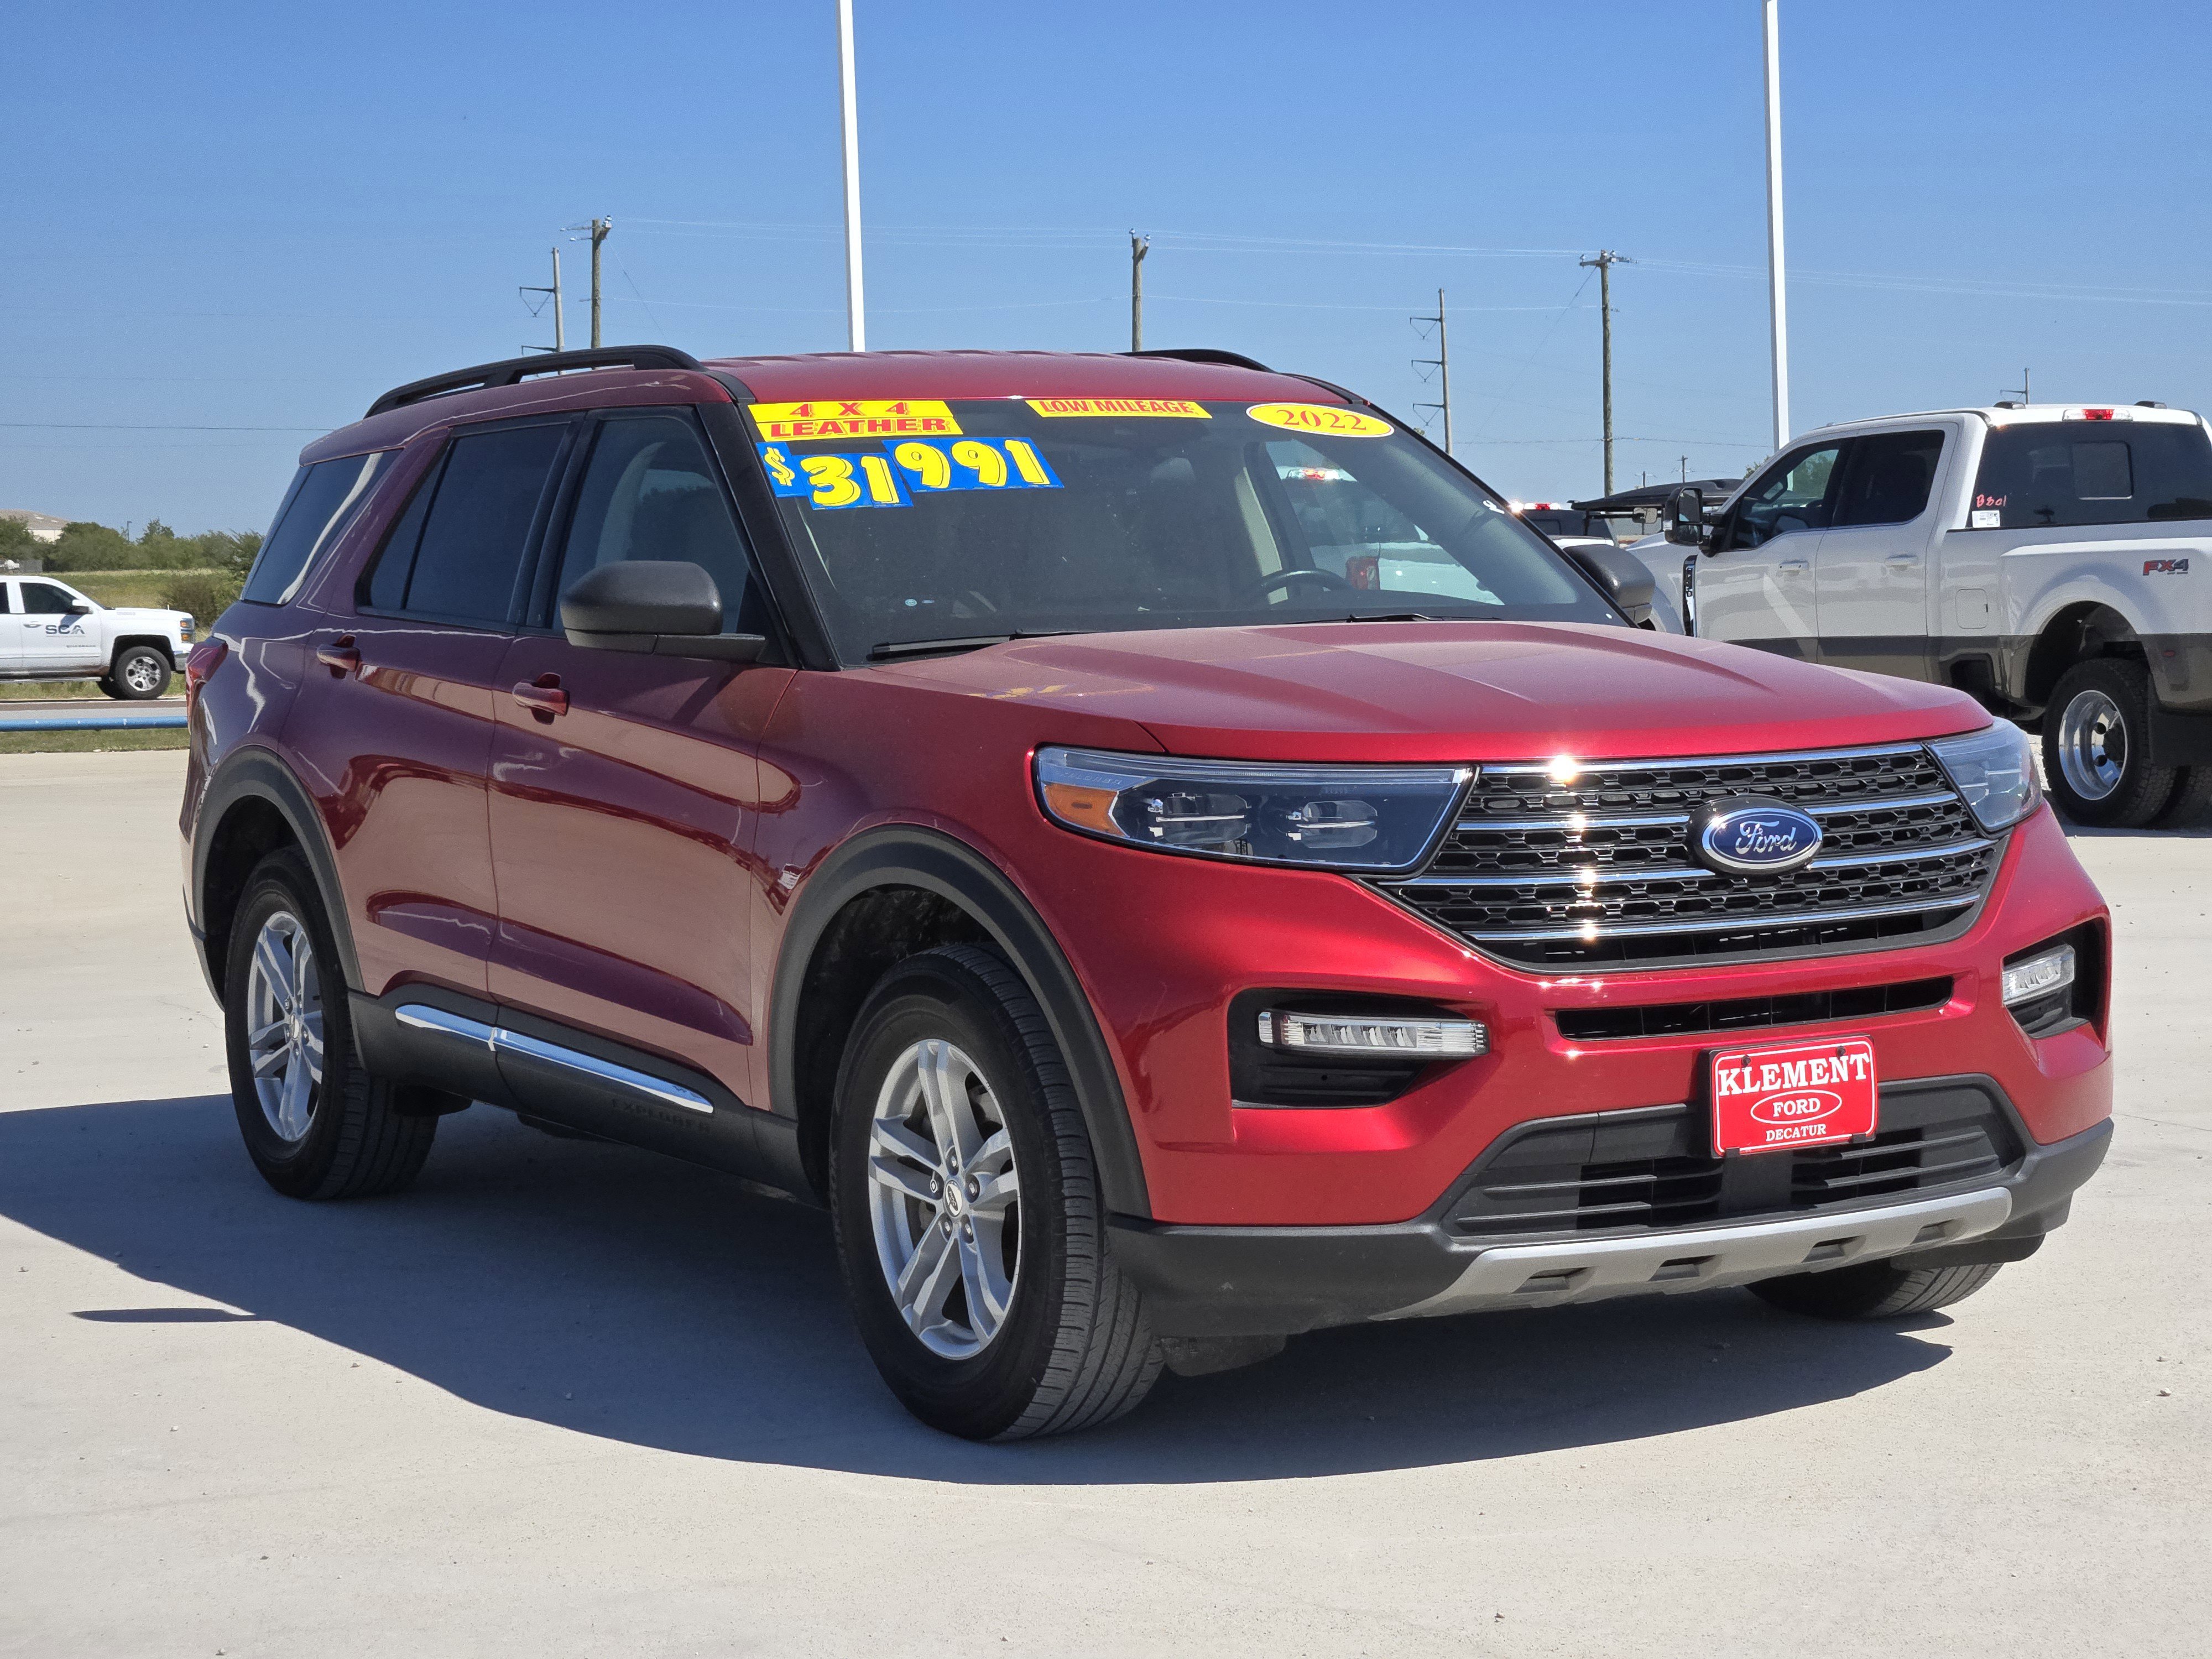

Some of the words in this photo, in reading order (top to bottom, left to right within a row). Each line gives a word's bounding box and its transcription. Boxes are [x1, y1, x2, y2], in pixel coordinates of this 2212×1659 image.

[789, 403, 813, 417] 4
[838, 402, 864, 416] X
[885, 401, 908, 415] 4
[1039, 400, 1092, 414] LOW
[1093, 400, 1198, 414] MILEAGE
[770, 418, 951, 439] LEATHER
[1276, 409, 1367, 430] 2022
[2142, 559, 2189, 576] FX4
[45, 624, 85, 634] SCA
[1735, 821, 1797, 854] Ford
[1718, 1052, 1870, 1096] KLEMENT
[1772, 1098, 1821, 1117] FORD
[1765, 1123, 1827, 1142] DECATUR
